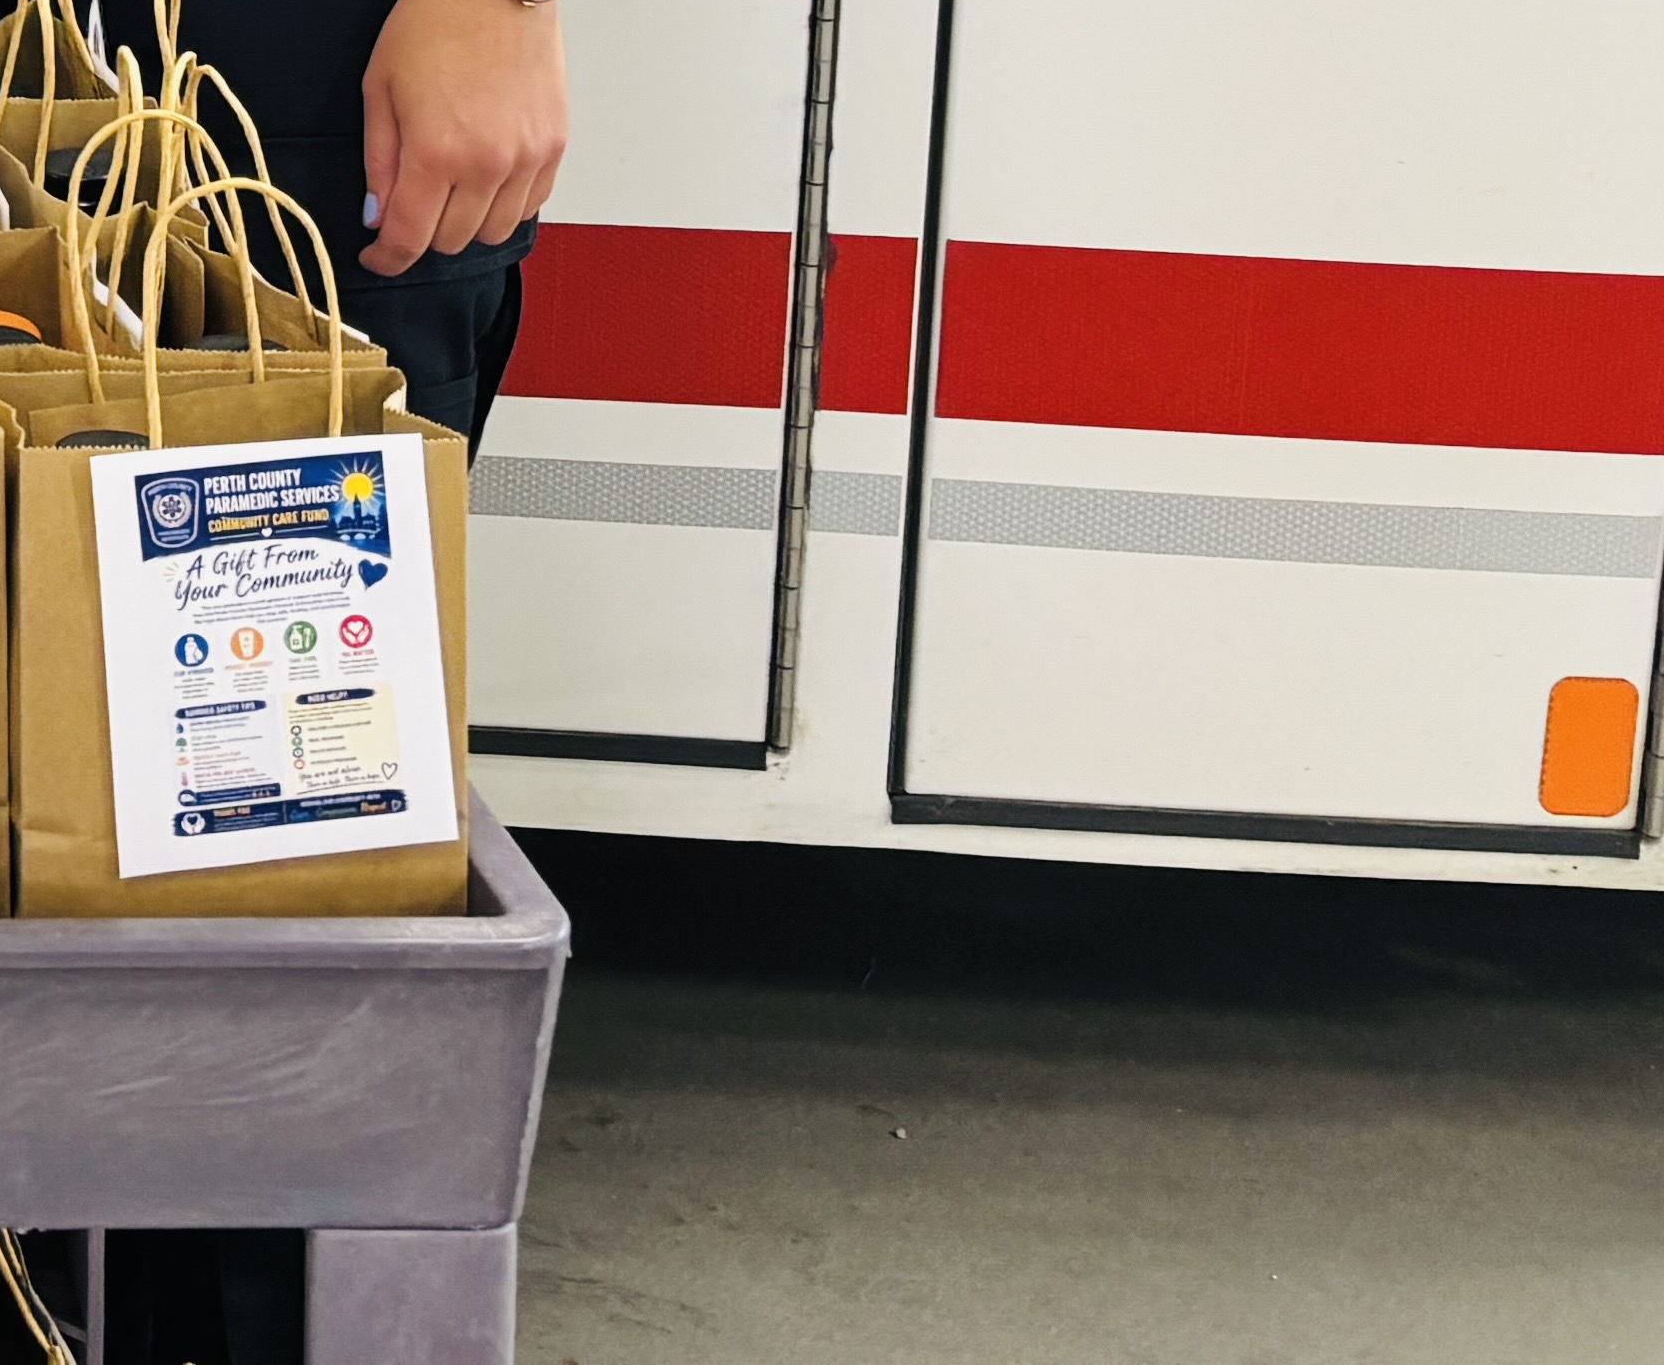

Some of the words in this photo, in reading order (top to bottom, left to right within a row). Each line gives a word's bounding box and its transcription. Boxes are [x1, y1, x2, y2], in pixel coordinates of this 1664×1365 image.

[203, 477, 246, 496] PERTH
[249, 468, 301, 491] COUNTY
[205, 491, 278, 515] PARAMEDIC
[281, 484, 340, 506] SERVICES
[207, 515, 270, 533] COMMUNITY
[272, 512, 299, 526] CARE
[301, 508, 330, 522] FUND
[186, 555, 205, 579] A
[213, 550, 259, 577] Gift
[264, 544, 319, 568] From
[175, 580, 228, 611] Your
[235, 558, 354, 598] Community
